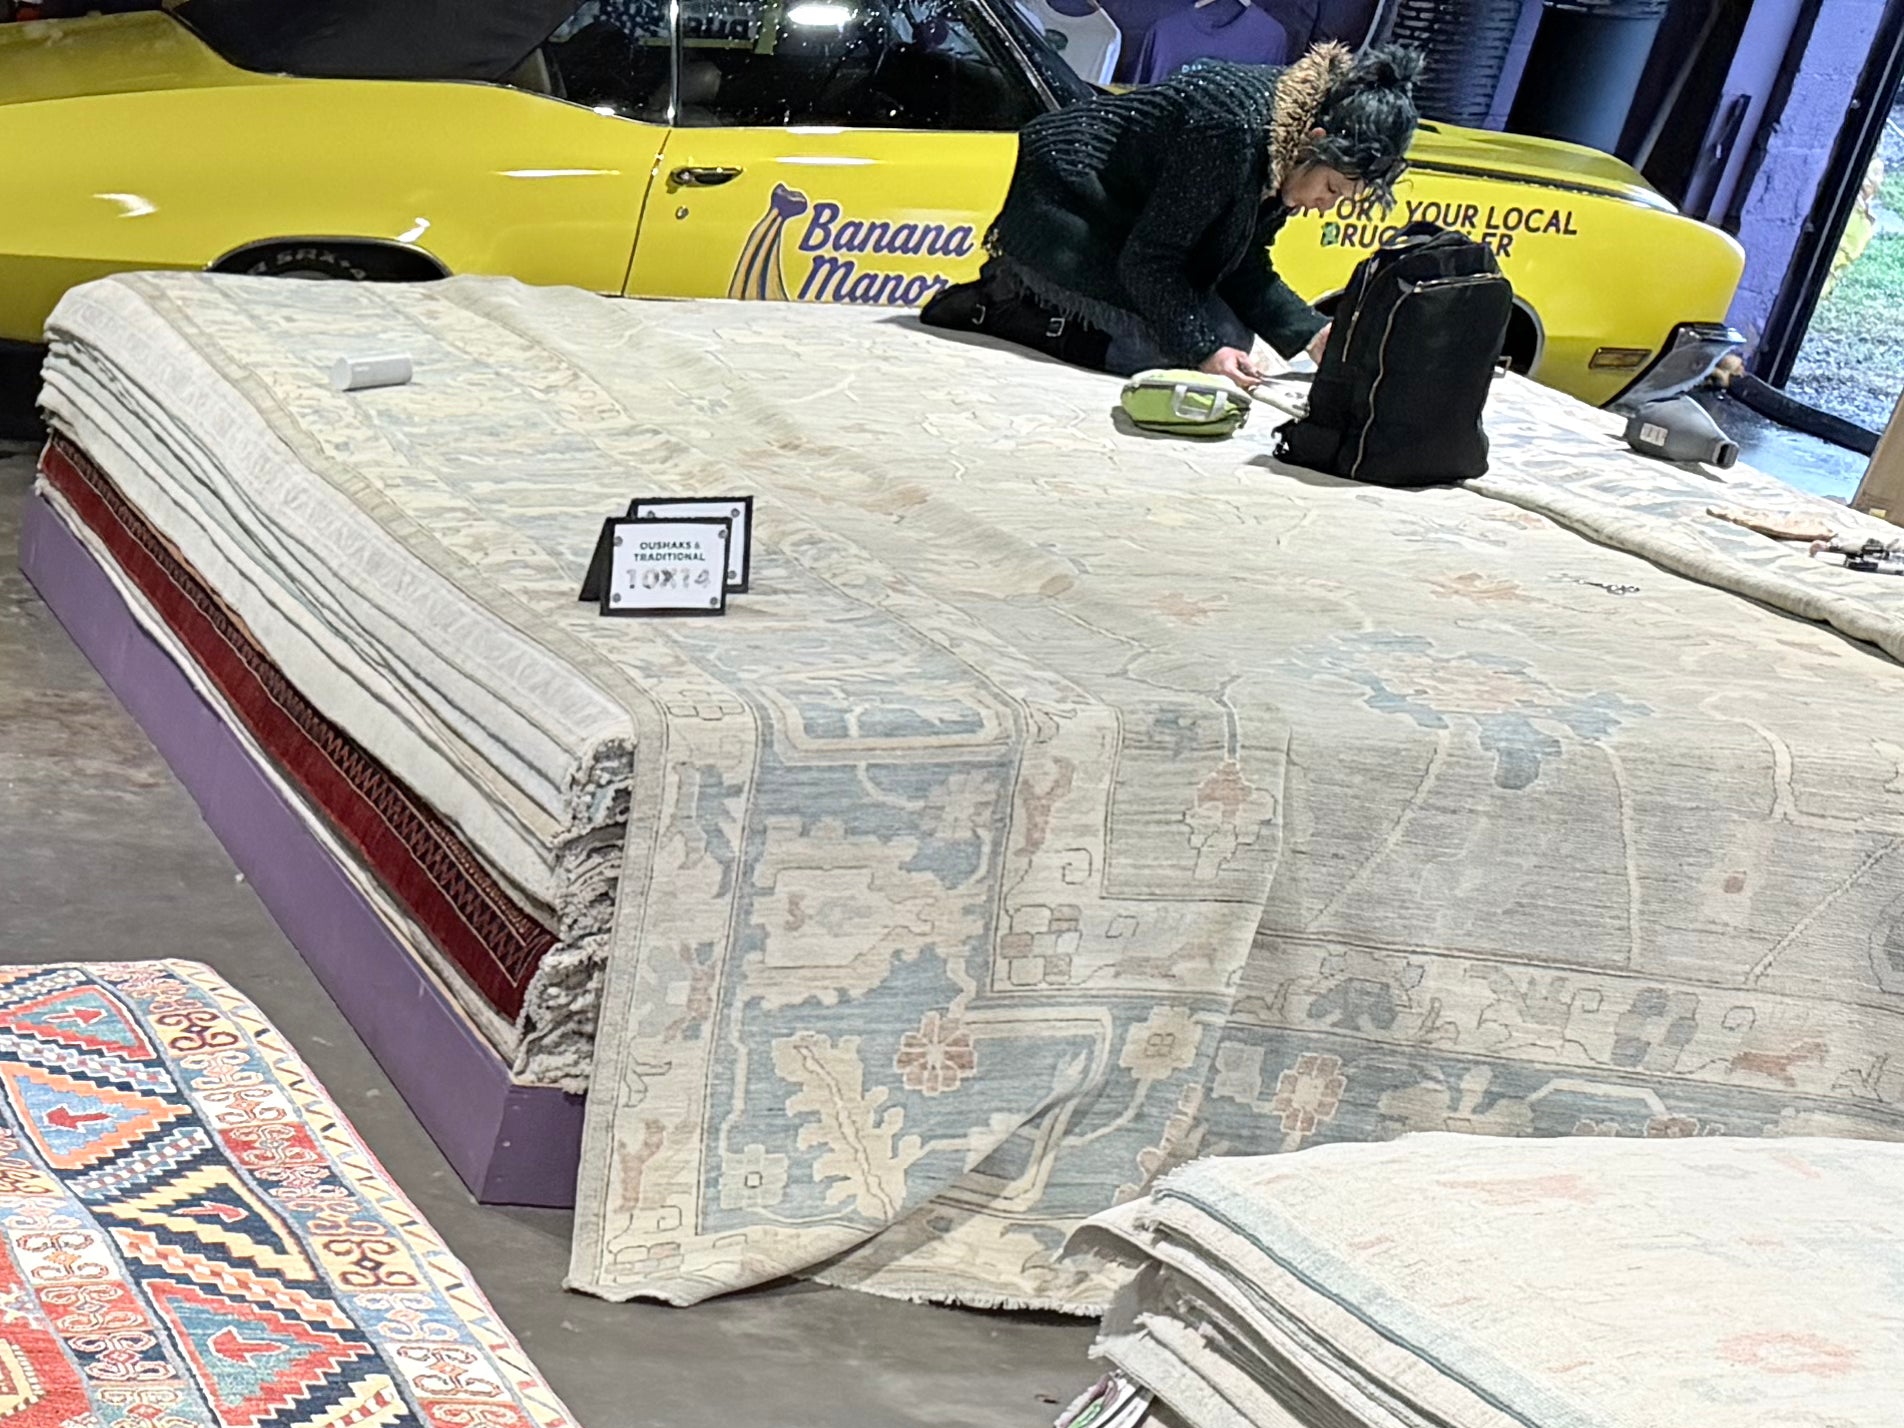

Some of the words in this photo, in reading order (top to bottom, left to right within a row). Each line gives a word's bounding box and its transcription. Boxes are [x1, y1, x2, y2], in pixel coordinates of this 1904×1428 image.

[798, 202, 974, 257] Banana
[1403, 200, 1479, 229] YOUR
[1485, 206, 1578, 235] LOCAL
[797, 254, 949, 305] Manor
[633, 552, 706, 562] TRADITIONAL
[639, 541, 692, 550] OUSHAKS
[626, 569, 711, 589] 10X14
